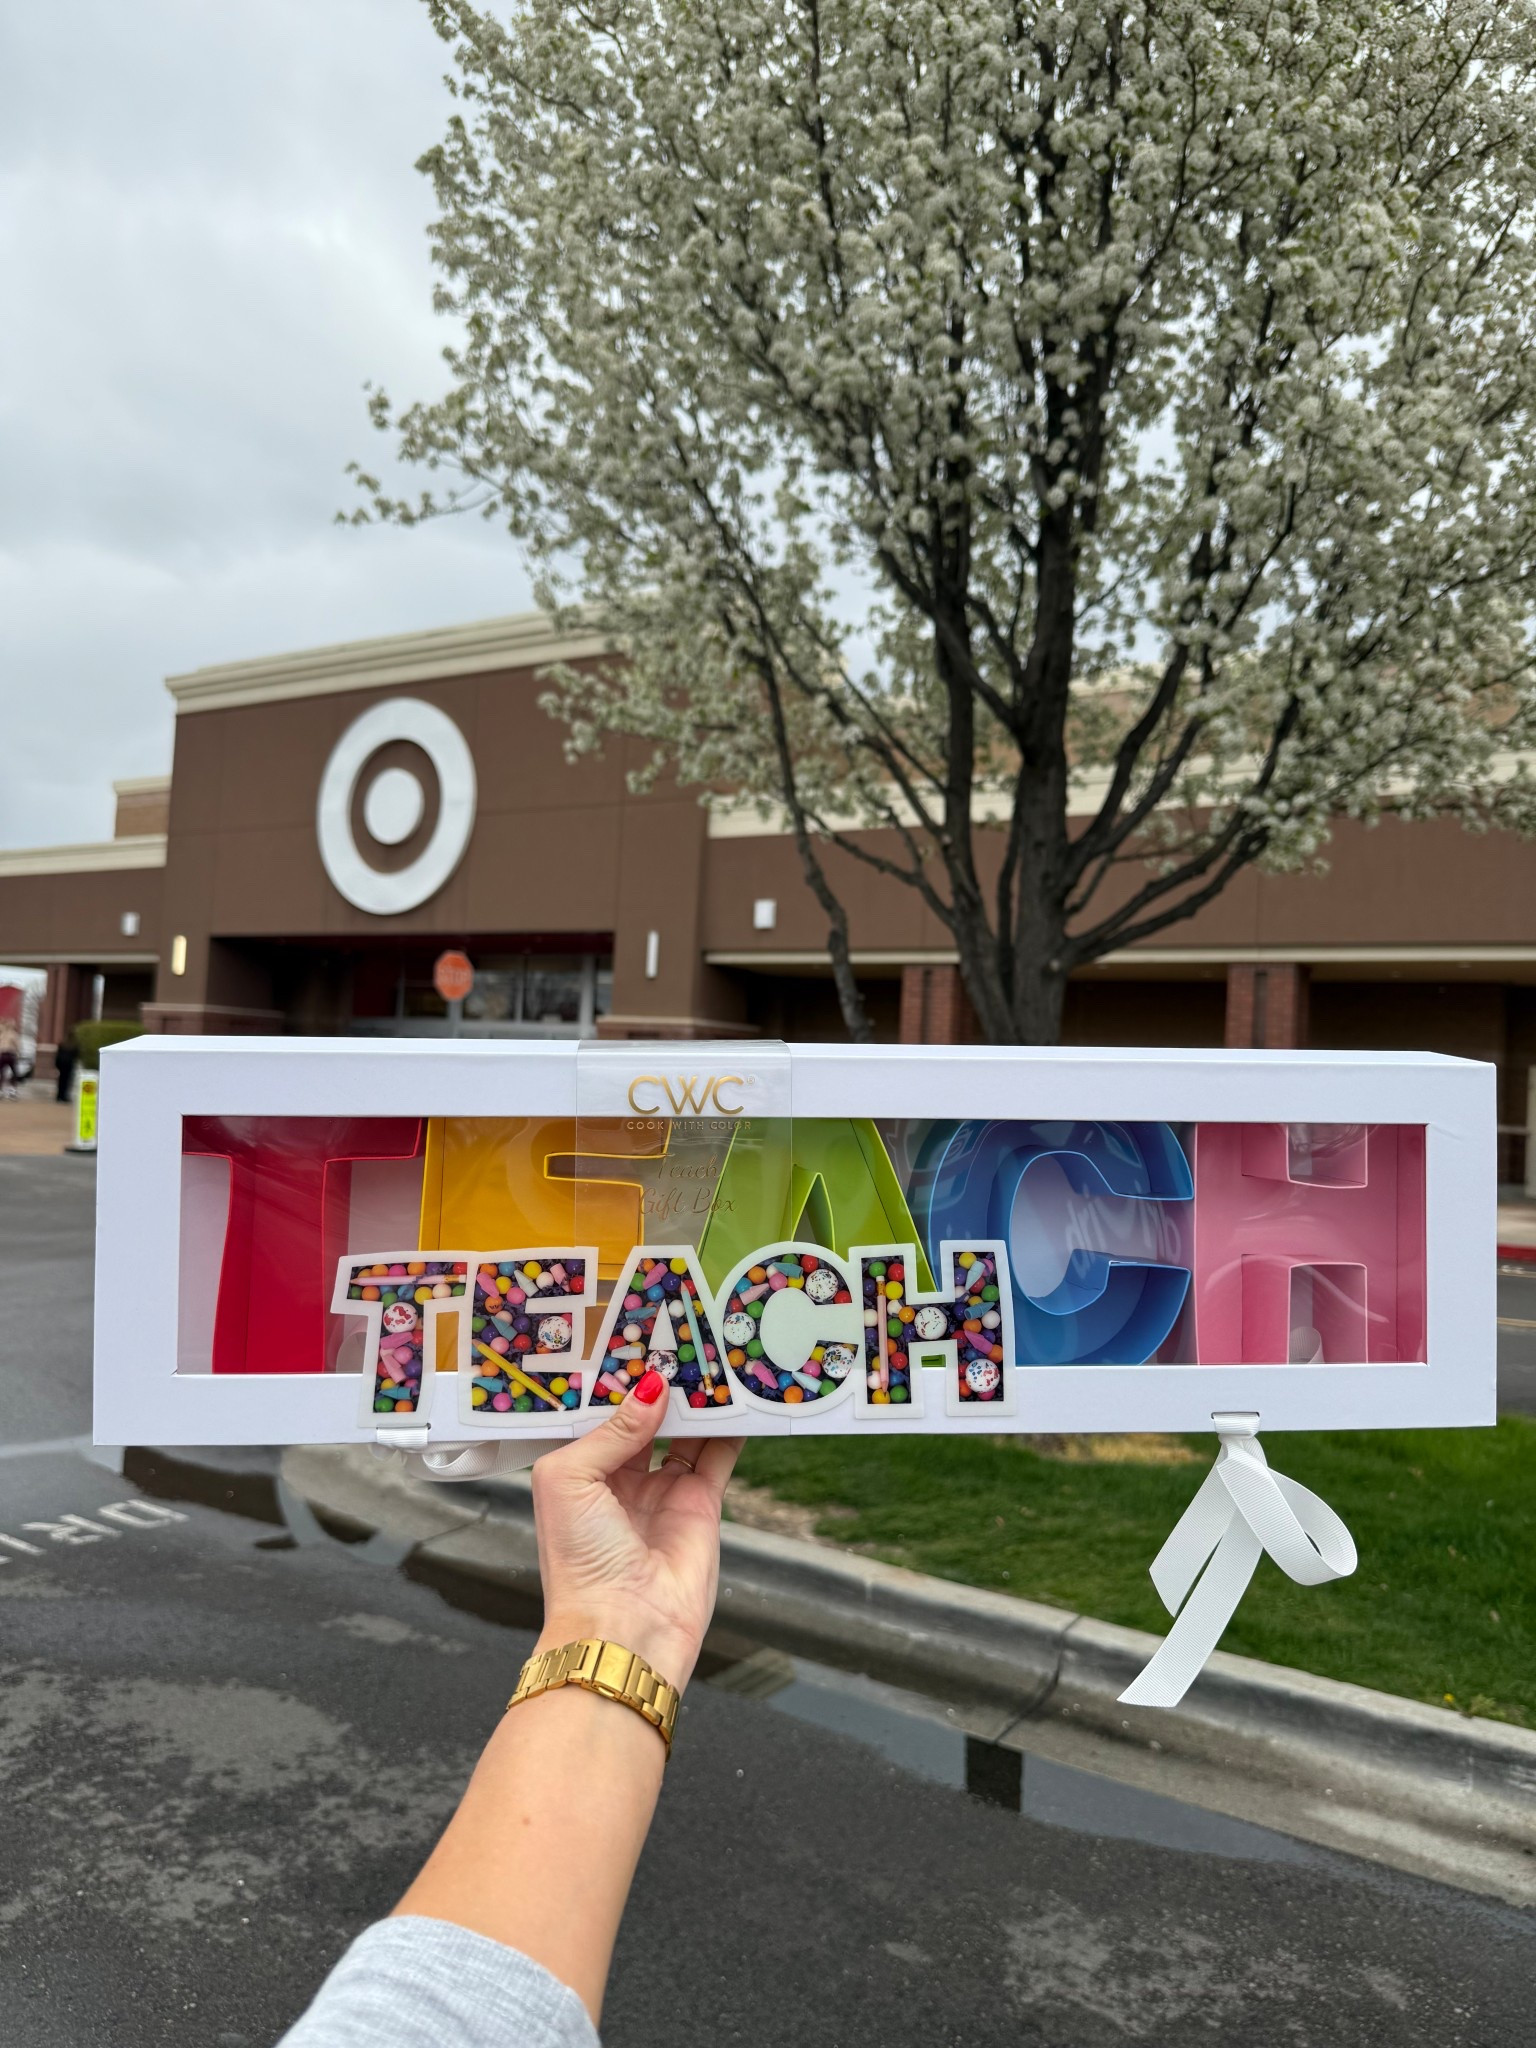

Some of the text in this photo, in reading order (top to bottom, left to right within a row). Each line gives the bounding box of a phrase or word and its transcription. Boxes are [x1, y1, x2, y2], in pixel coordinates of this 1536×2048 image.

[436, 965, 472, 986] STOP
[627, 1075, 745, 1115] CWC
[626, 1121, 752, 1130] COOK WITH COLOR
[658, 1153, 719, 1180] Teach
[639, 1187, 737, 1221] Gift Box
[330, 1240, 1016, 1427] TEACH
[0, 1499, 190, 1565] DRI
